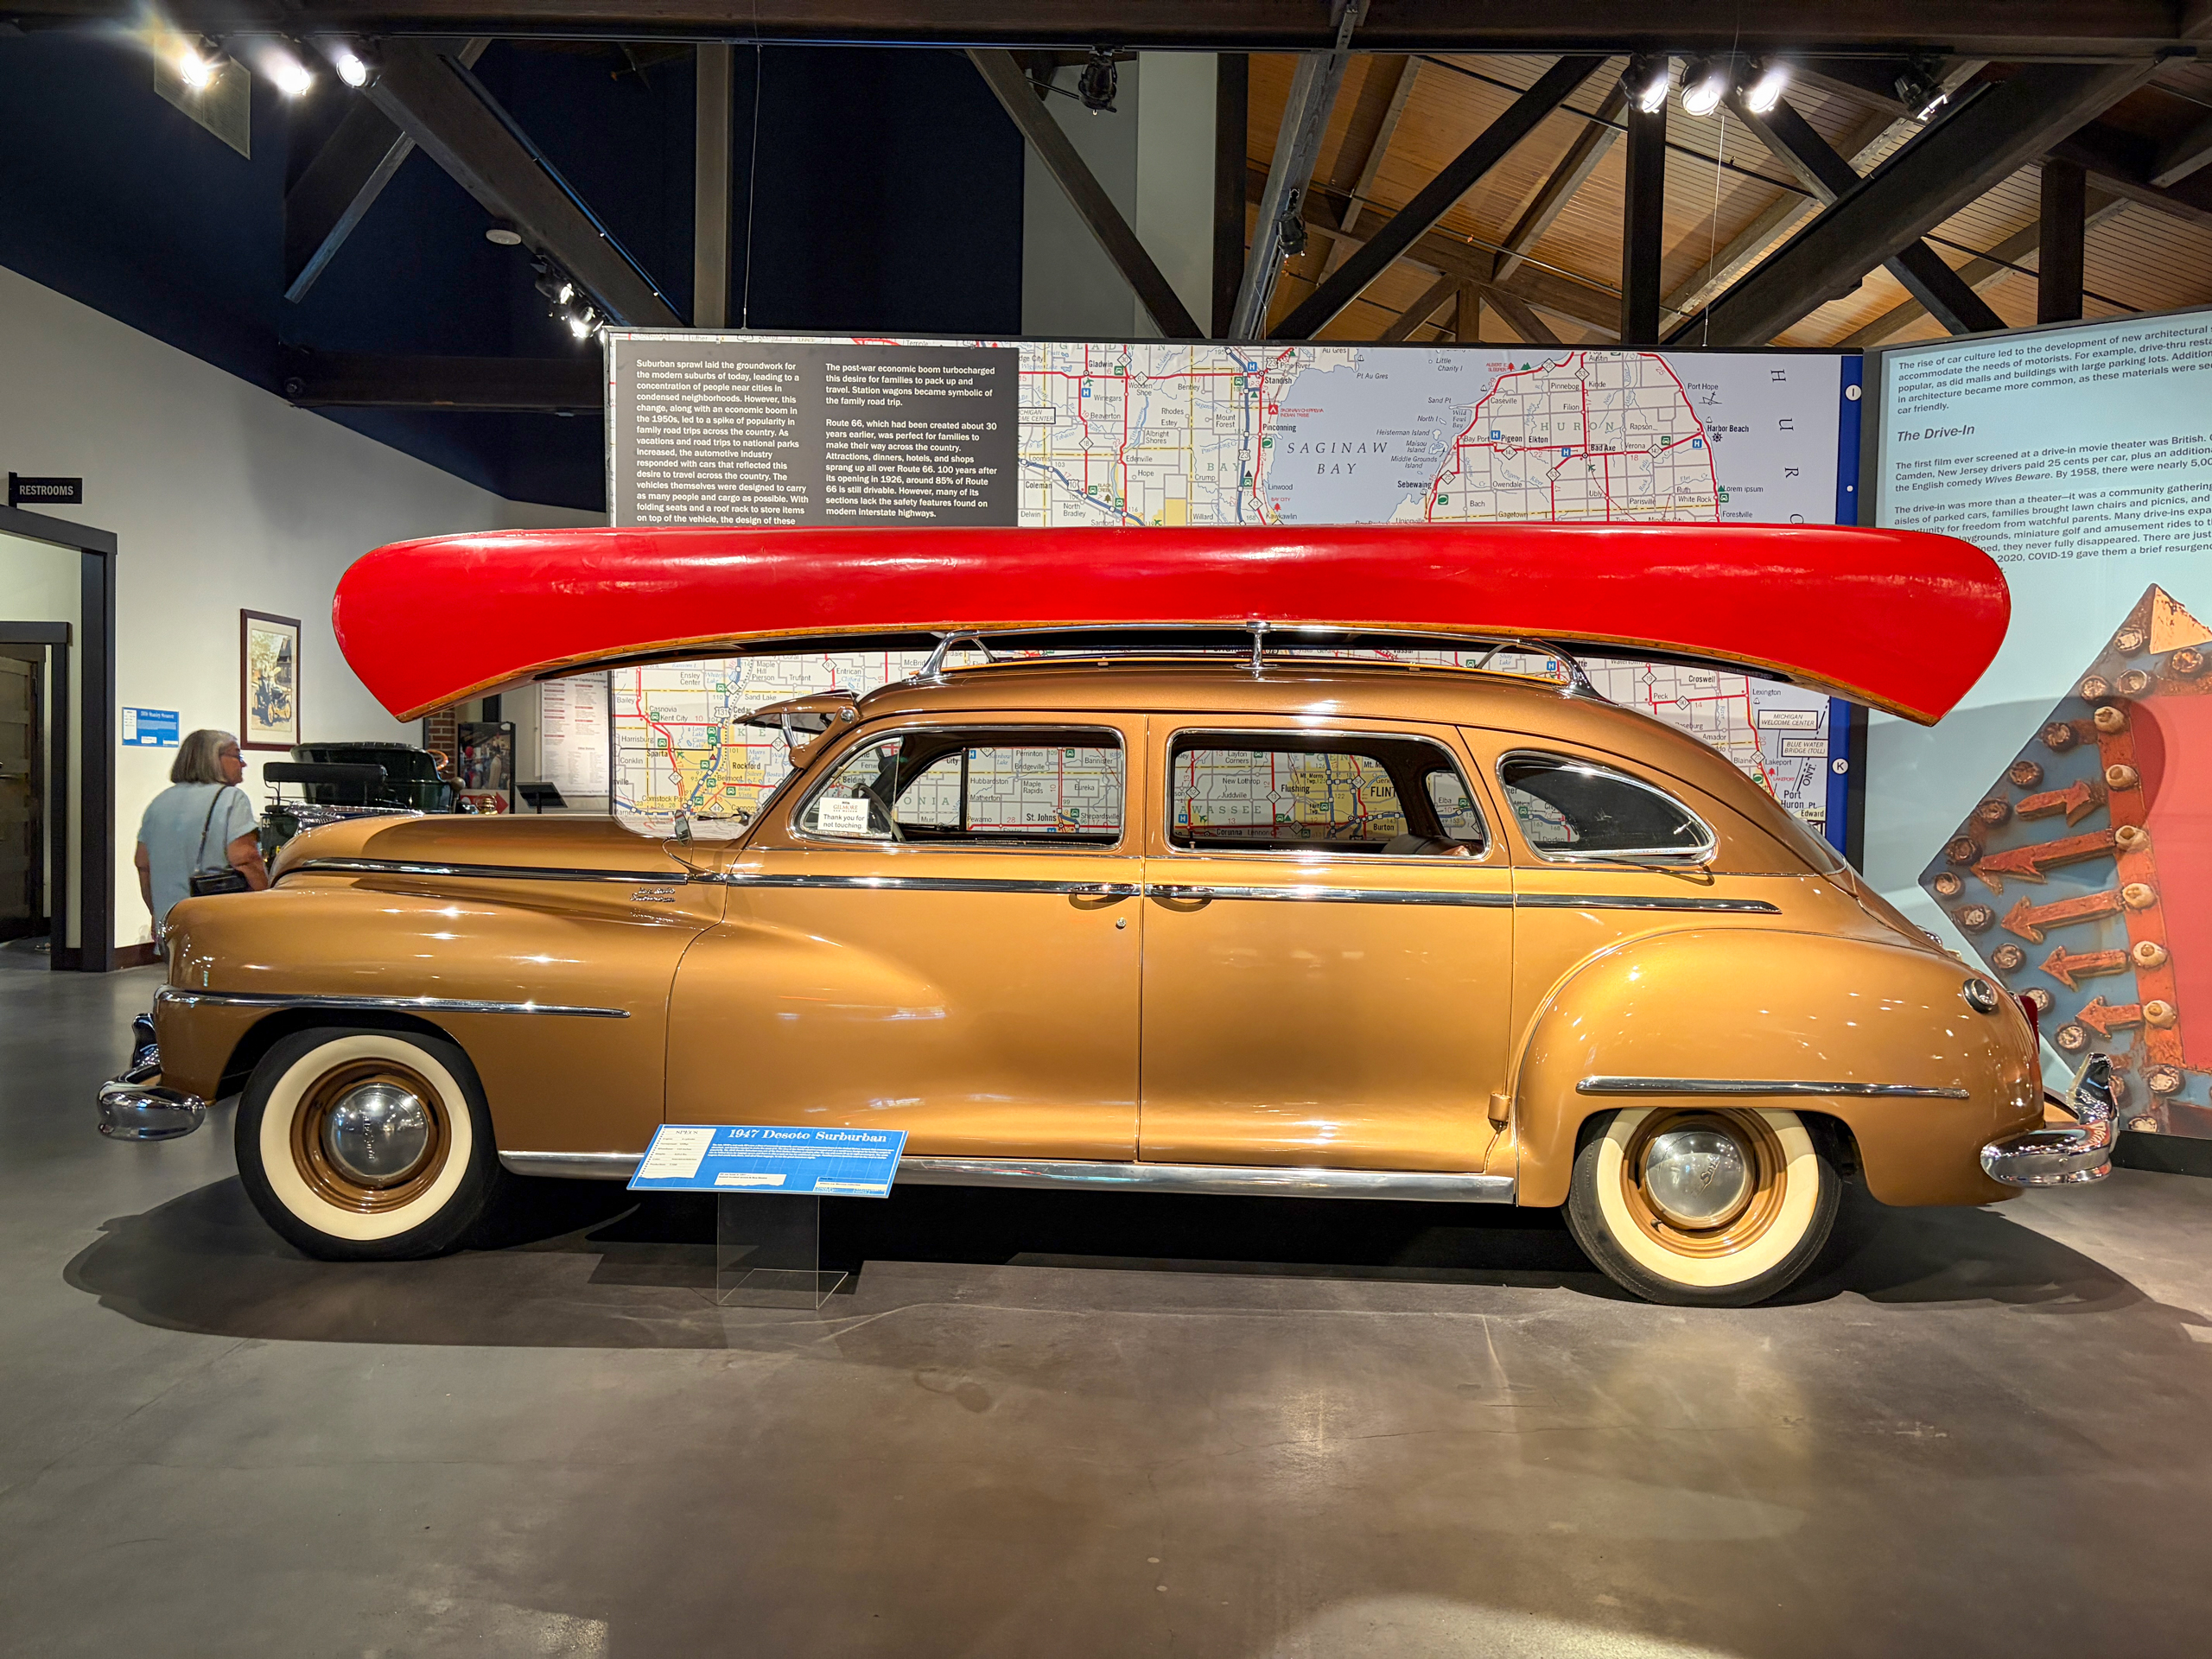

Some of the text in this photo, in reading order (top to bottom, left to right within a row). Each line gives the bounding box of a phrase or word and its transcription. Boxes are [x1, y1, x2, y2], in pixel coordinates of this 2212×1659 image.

[1964, 353, 1995, 361] culture
[2044, 338, 2107, 352] development
[2109, 335, 2120, 344] of
[2145, 325, 2208, 340] architectural
[1898, 368, 1962, 381] accommodate
[1983, 361, 2011, 371] needs
[2013, 359, 2022, 367] of
[2025, 354, 2072, 365] motorists.
[2092, 346, 2136, 358] example,
[2139, 341, 2186, 353] drive-thru
[736, 362, 783, 371] groundwork
[943, 366, 995, 376] turbocharged
[728, 372, 751, 382] today,
[753, 373, 783, 382] leading
[925, 377, 944, 385] pack
[703, 384, 730, 392] people
[948, 389, 982, 397] symbolic
[682, 393, 742, 403] neighborhoods.
[744, 395, 779, 404] However,
[841, 397, 866, 406] family
[887, 398, 903, 407] trip.
[1914, 403, 1948, 412] friendly.
[1897, 425, 1974, 442] The Drive-In
[1502, 435, 1522, 443] Pigeon
[1287, 442, 1388, 454] SAGINAW
[1976, 451, 2018, 462] screened
[2042, 447, 2075, 455] drive-in
[2079, 443, 2108, 453] movie
[2111, 441, 2146, 449] theater
[2171, 435, 2206, 444] British.
[1318, 463, 1357, 474] BAY
[1398, 480, 1432, 489] Sebewaing
[20, 486, 73, 495] RESTROOMS
[1997, 553, 2025, 563] 2020,
[2028, 550, 2074, 561] COVID-19
[2076, 550, 2099, 559] gave
[2139, 545, 2162, 554] brief
[1281, 785, 1310, 794] Flushing
[728, 1129, 887, 1142] 1947 Desoto Surburban
